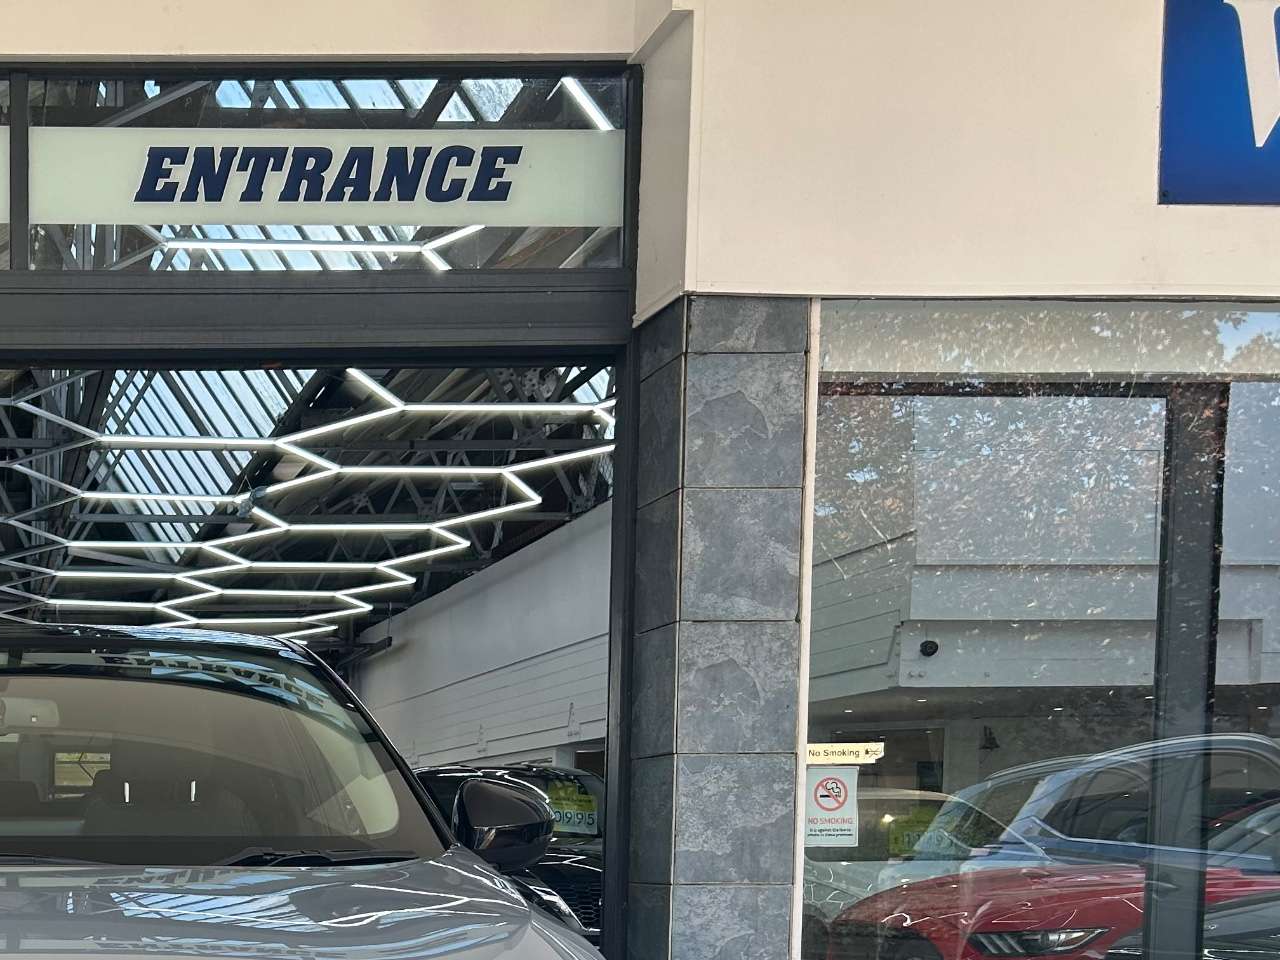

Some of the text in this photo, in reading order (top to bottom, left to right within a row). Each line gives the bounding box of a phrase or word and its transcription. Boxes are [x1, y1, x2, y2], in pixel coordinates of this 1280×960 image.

[132, 144, 524, 204] ENTRANCE
[808, 749, 860, 758] No Smoking
